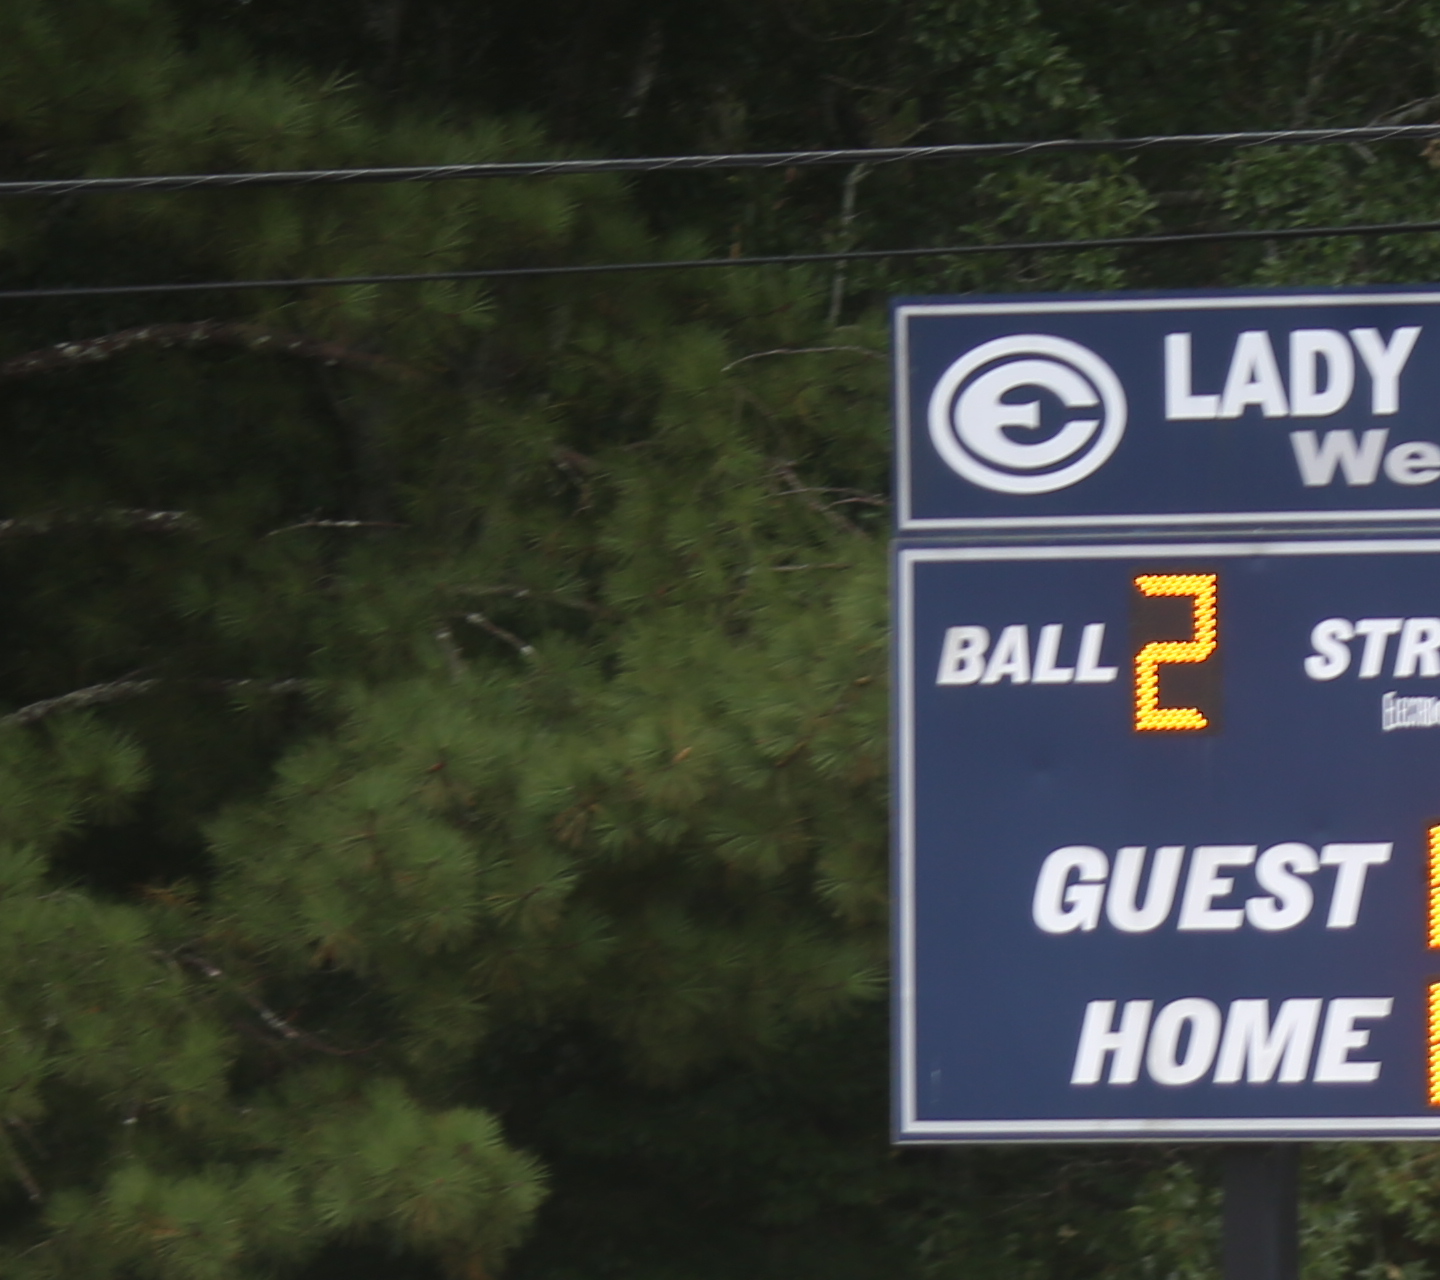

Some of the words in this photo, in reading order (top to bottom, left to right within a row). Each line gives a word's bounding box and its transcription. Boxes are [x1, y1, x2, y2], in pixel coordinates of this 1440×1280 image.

[1165, 325, 1422, 420] LADY
[936, 622, 1119, 686] BALL
[1133, 572, 1218, 732] 2
[1031, 841, 1392, 935] GUEST
[1071, 996, 1392, 1086] HOME
